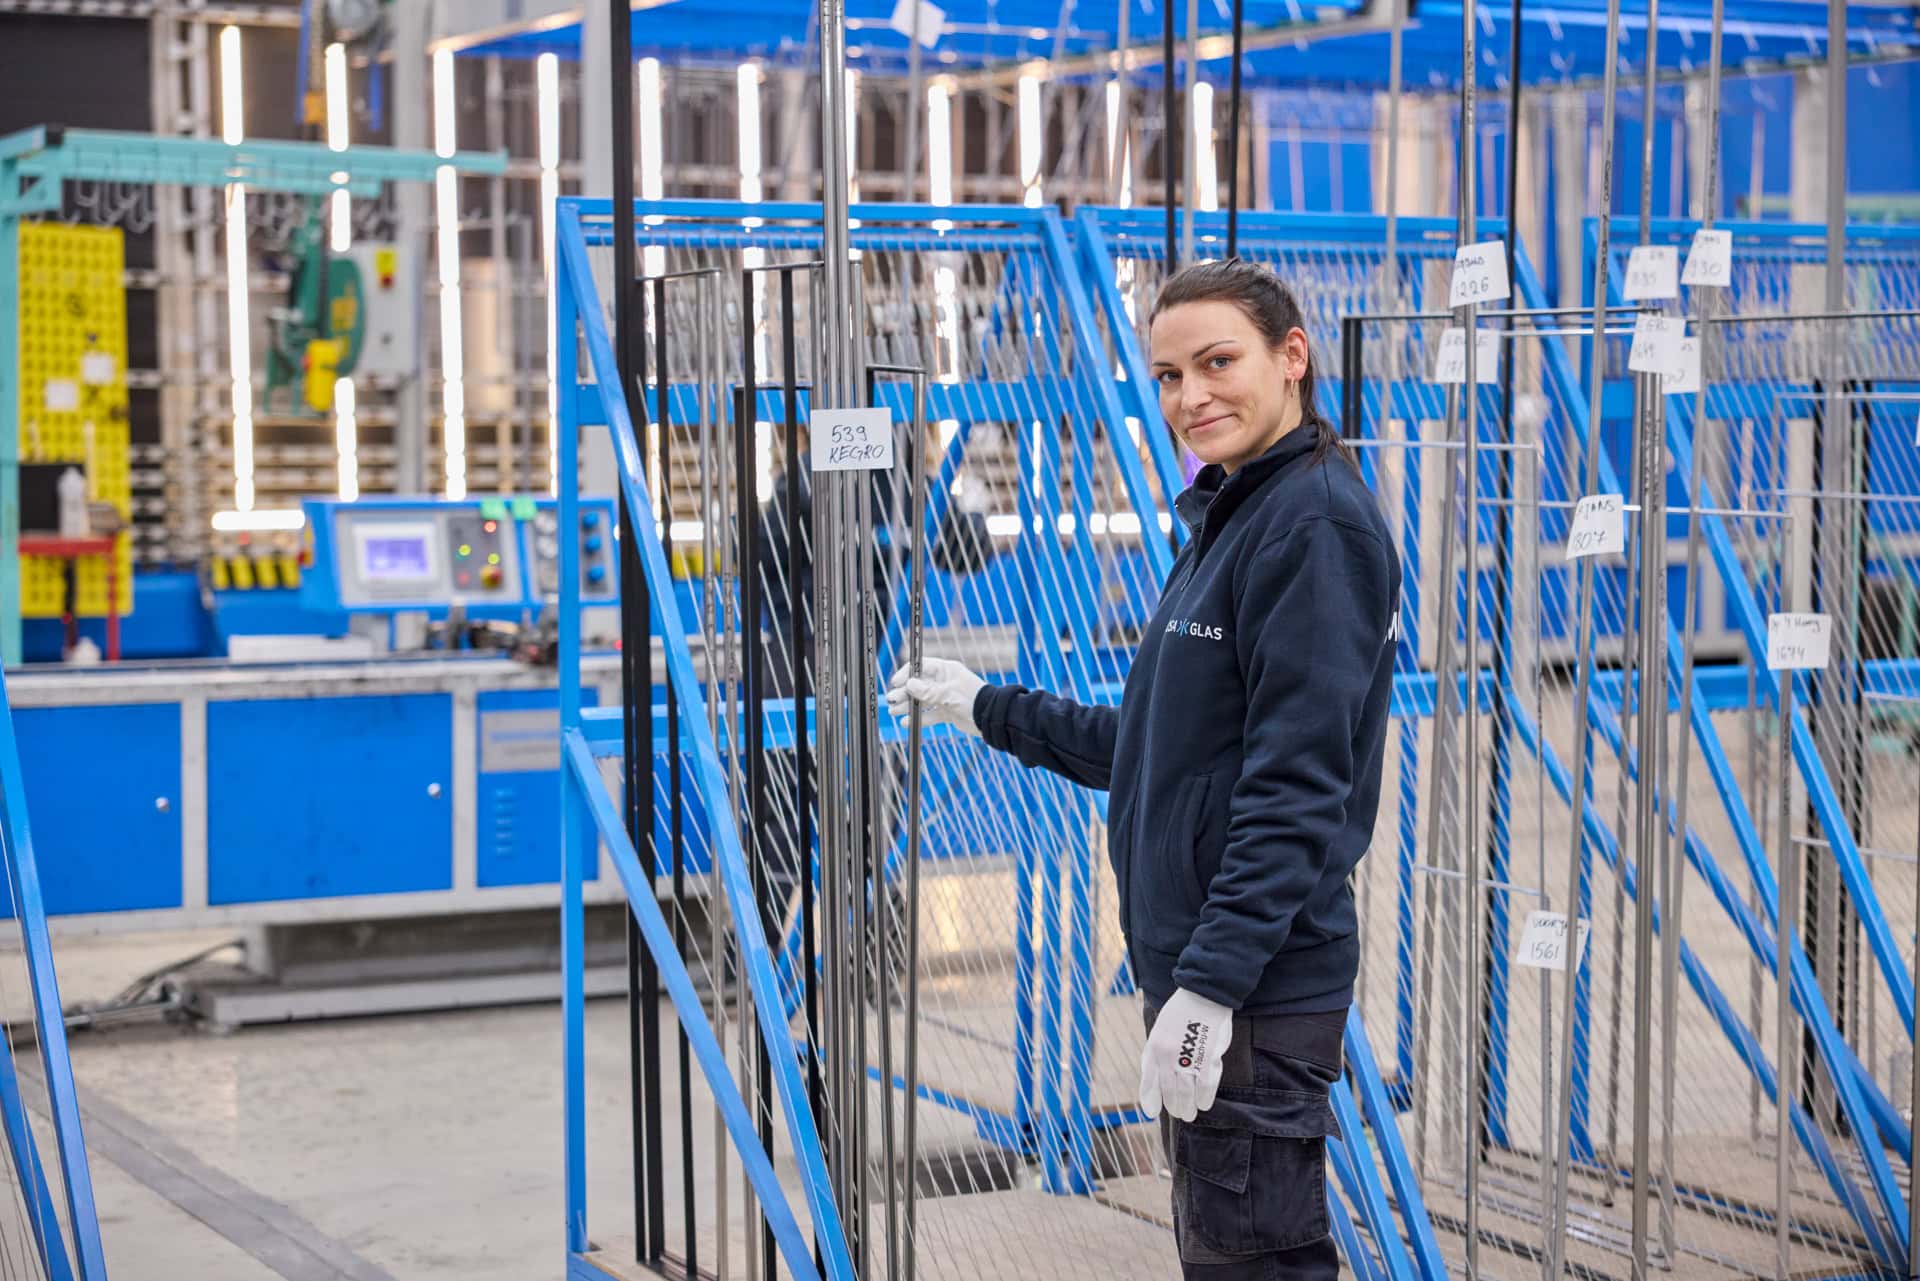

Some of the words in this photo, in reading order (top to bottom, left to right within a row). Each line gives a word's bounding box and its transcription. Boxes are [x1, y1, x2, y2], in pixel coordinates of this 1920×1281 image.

[832, 424, 867, 443] 539
[829, 445, 885, 464] KEGRO
[1190, 622, 1222, 640] GLAS
[1531, 942, 1559, 960] 1561
[1178, 1022, 1201, 1067] OXXA
